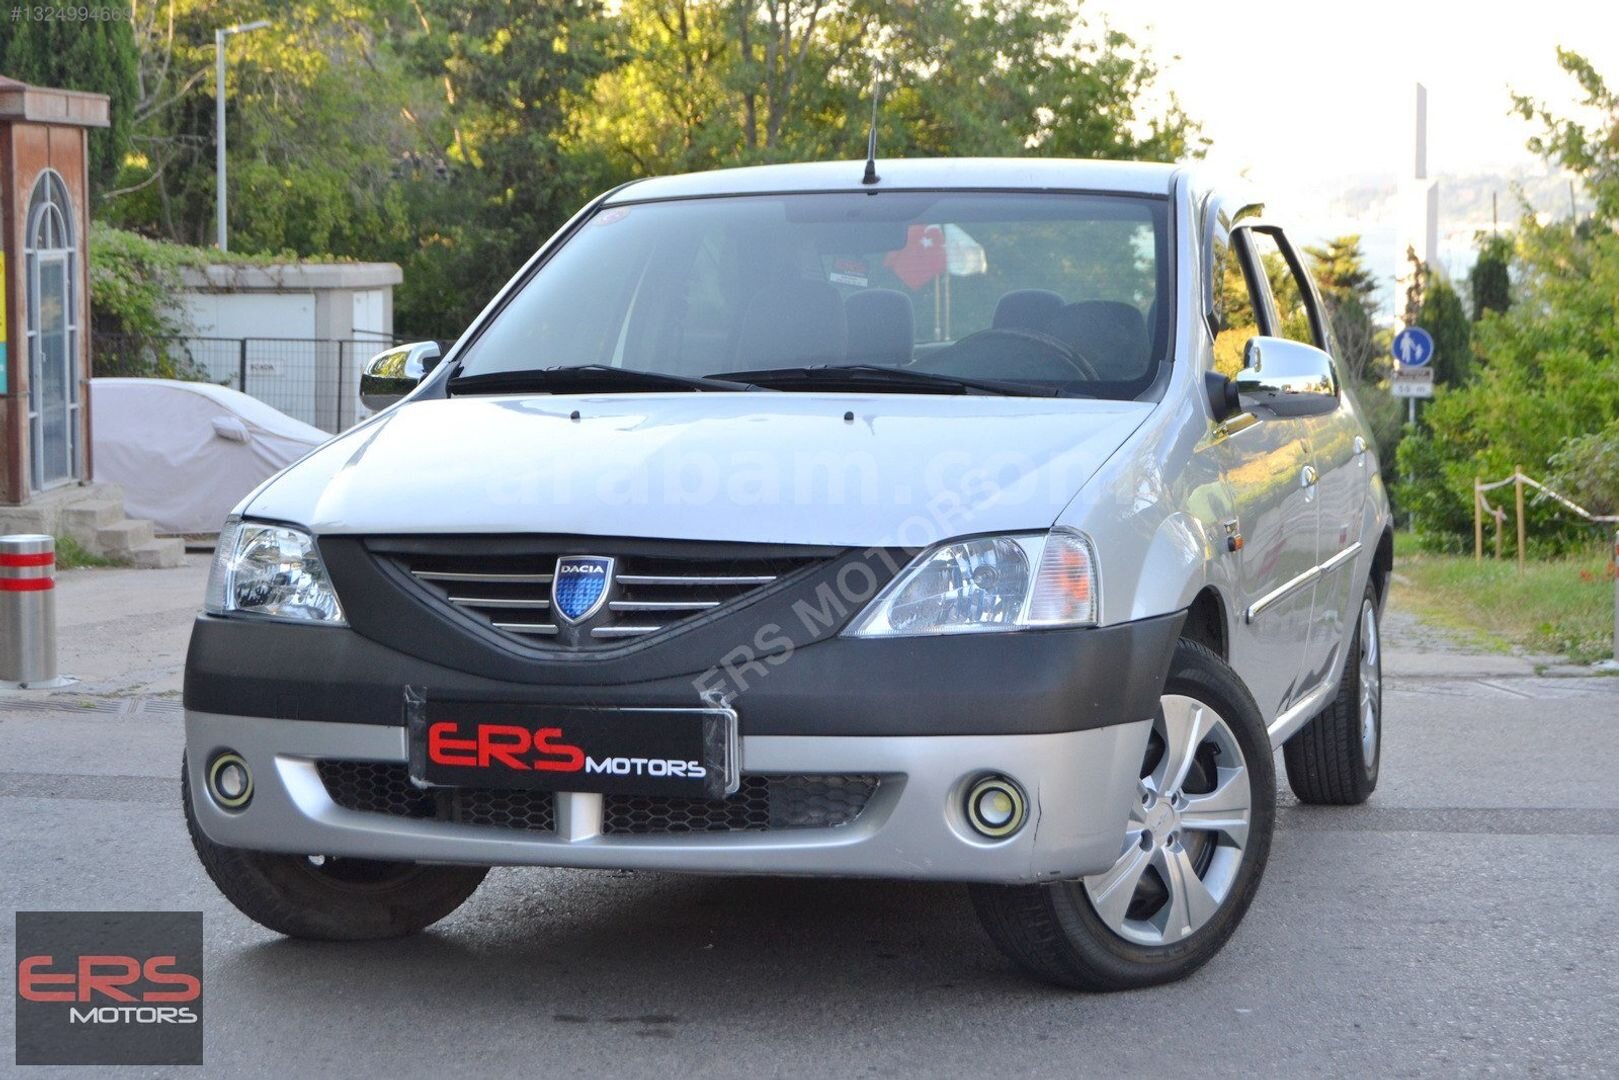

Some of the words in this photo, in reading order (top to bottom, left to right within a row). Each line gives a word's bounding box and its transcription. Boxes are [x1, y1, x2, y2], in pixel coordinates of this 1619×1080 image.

[560, 565, 605, 573] DACIA
[428, 721, 585, 773] ERS
[585, 756, 707, 778] MOTORS
